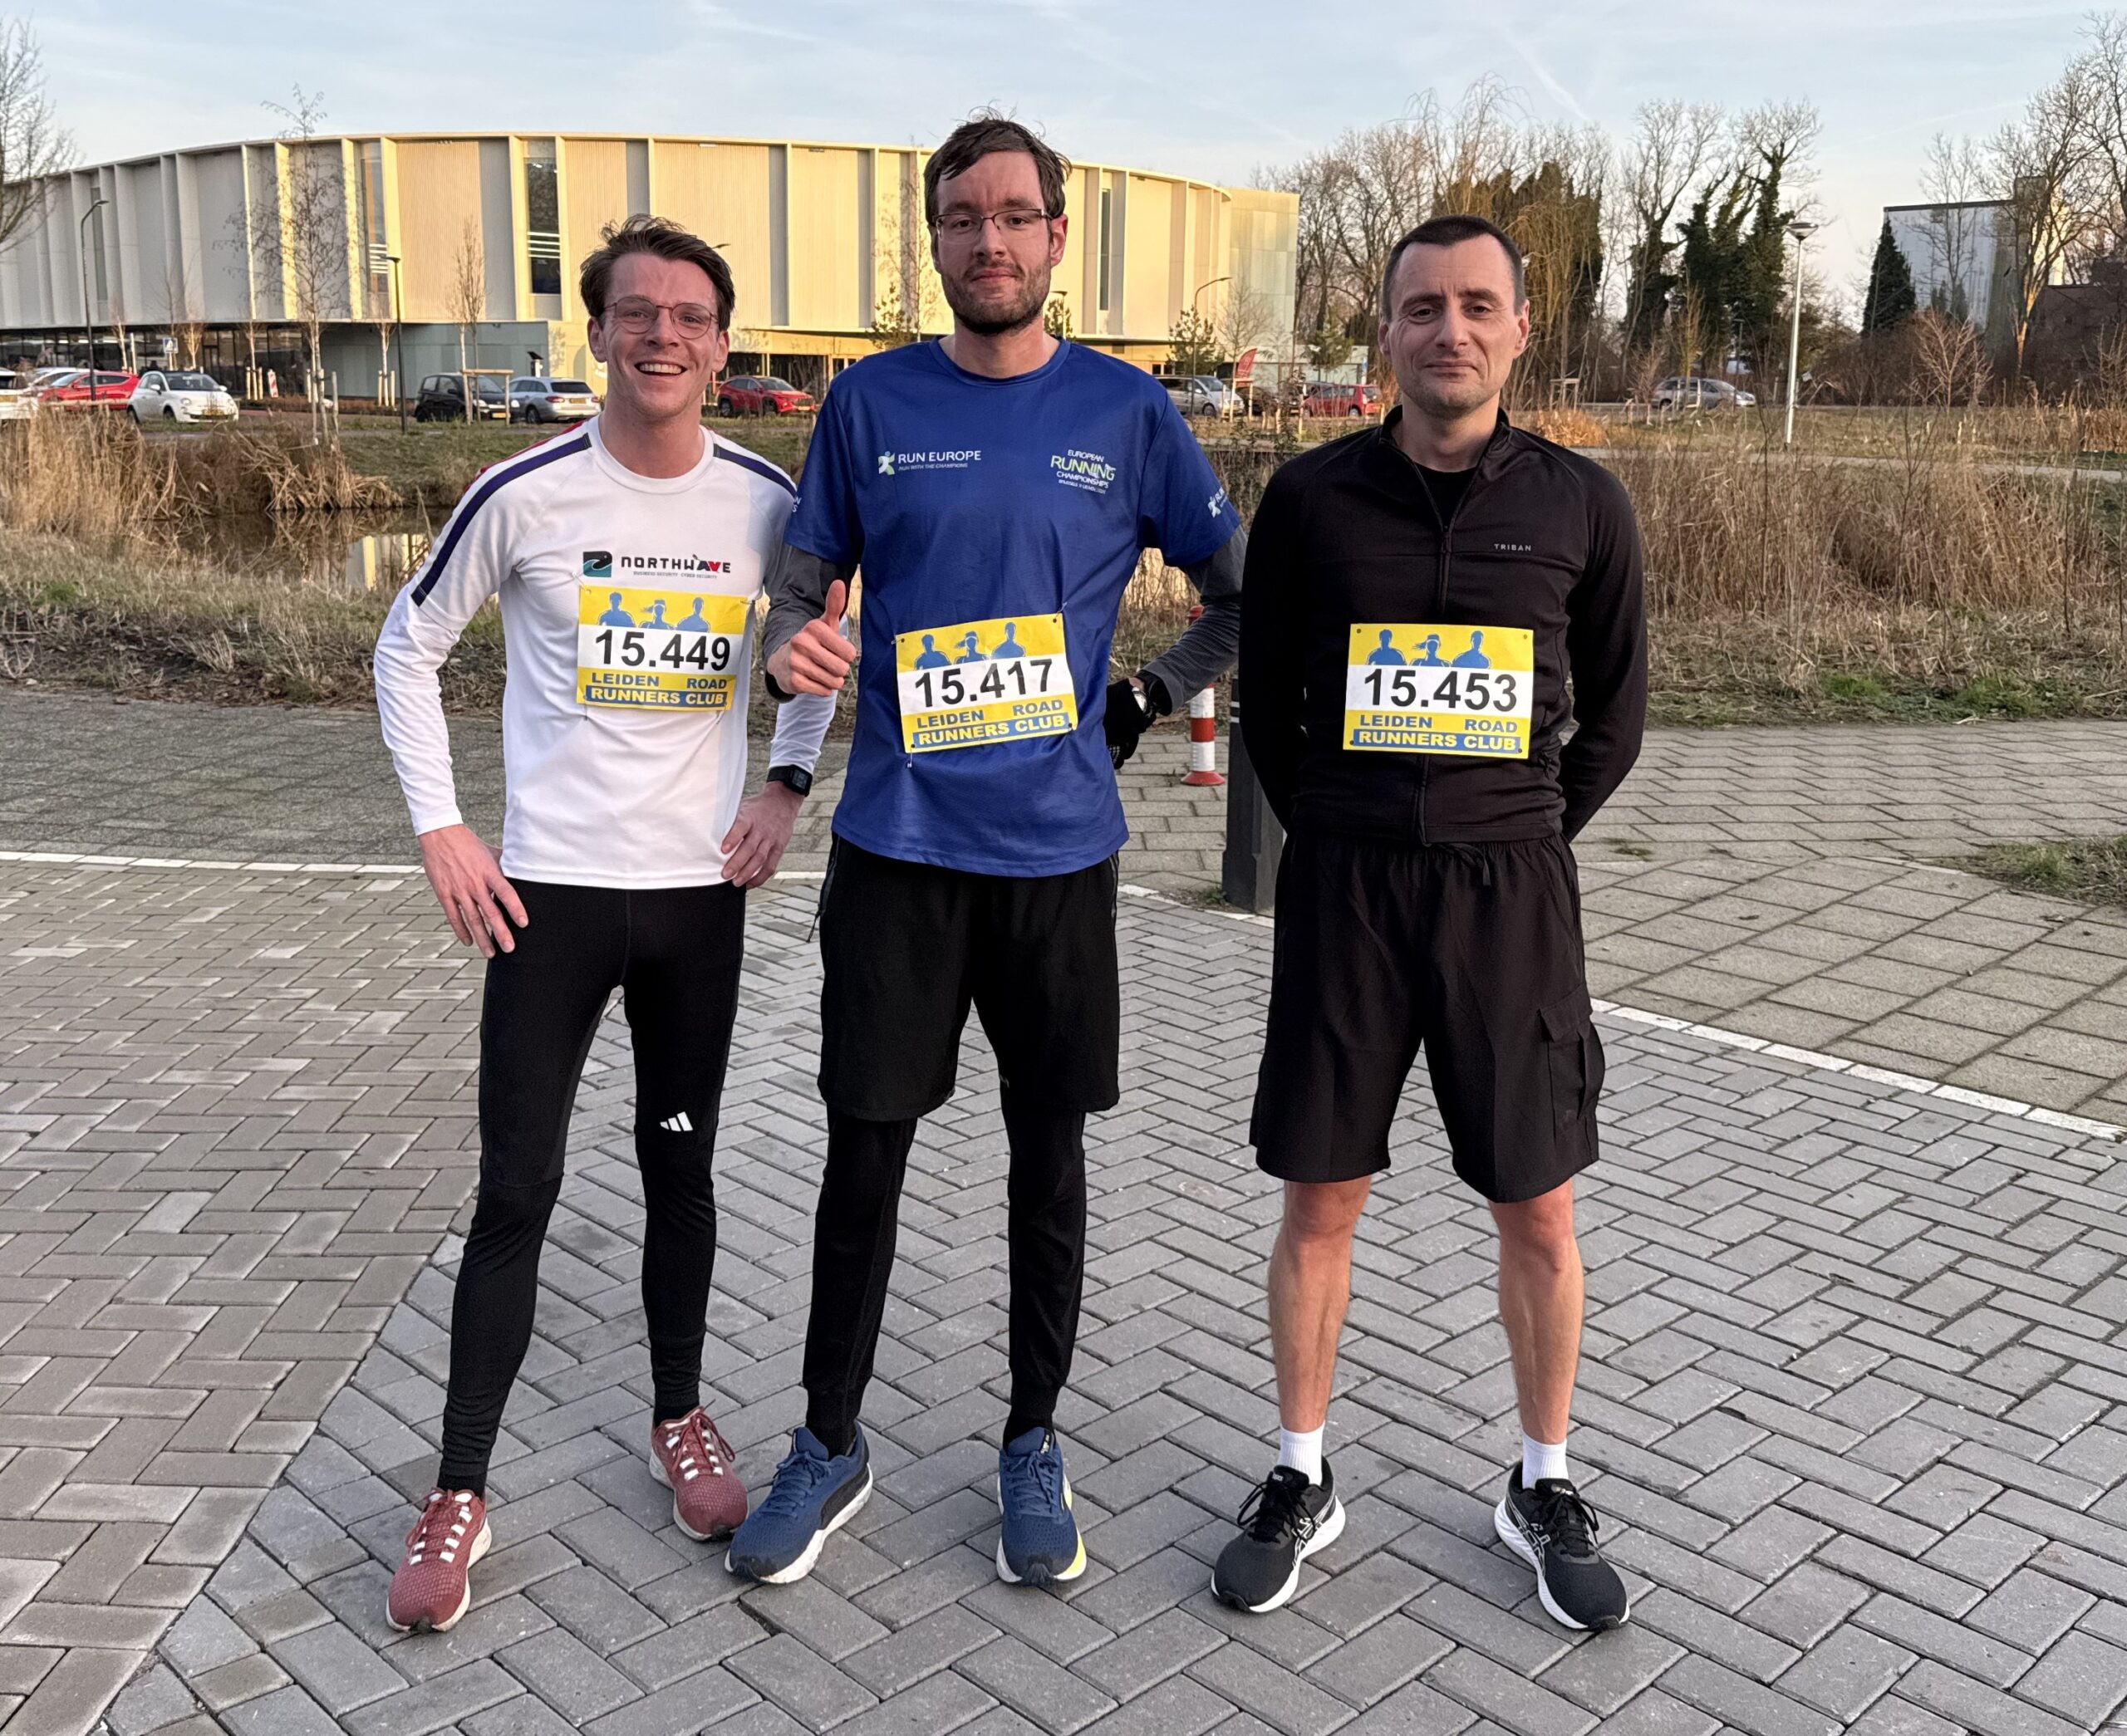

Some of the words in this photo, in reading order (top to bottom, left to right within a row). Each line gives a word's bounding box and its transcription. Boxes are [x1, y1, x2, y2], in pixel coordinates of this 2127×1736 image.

[898, 452, 926, 463] RUN
[928, 450, 982, 462] EUROPE
[1067, 449, 1104, 463] EUROPEAN
[1050, 455, 1116, 481] RUNNING
[1056, 471, 1109, 488] CHAMPIONSHIPS
[1494, 543, 1531, 552] TRIBAN
[621, 556, 731, 573] NORTHWAVE
[596, 629, 730, 671] 15.449
[592, 672, 660, 687] LEIDEN
[686, 678, 727, 689] ROAD
[915, 659, 1053, 708] 15.417
[1364, 668, 1517, 712] 15.453
[591, 688, 680, 704] RUNNERS
[685, 693, 725, 705] CLUB
[917, 709, 985, 728] LEIDEN
[1012, 699, 1064, 716] ROAD
[919, 724, 1009, 745] RUNNERS
[1015, 715, 1065, 732] CLUB
[1360, 714, 1432, 728] LEIDEN
[1465, 719, 1517, 733] ROAD
[1359, 731, 1456, 747] RUNNERS
[1463, 735, 1516, 751] CLUB
